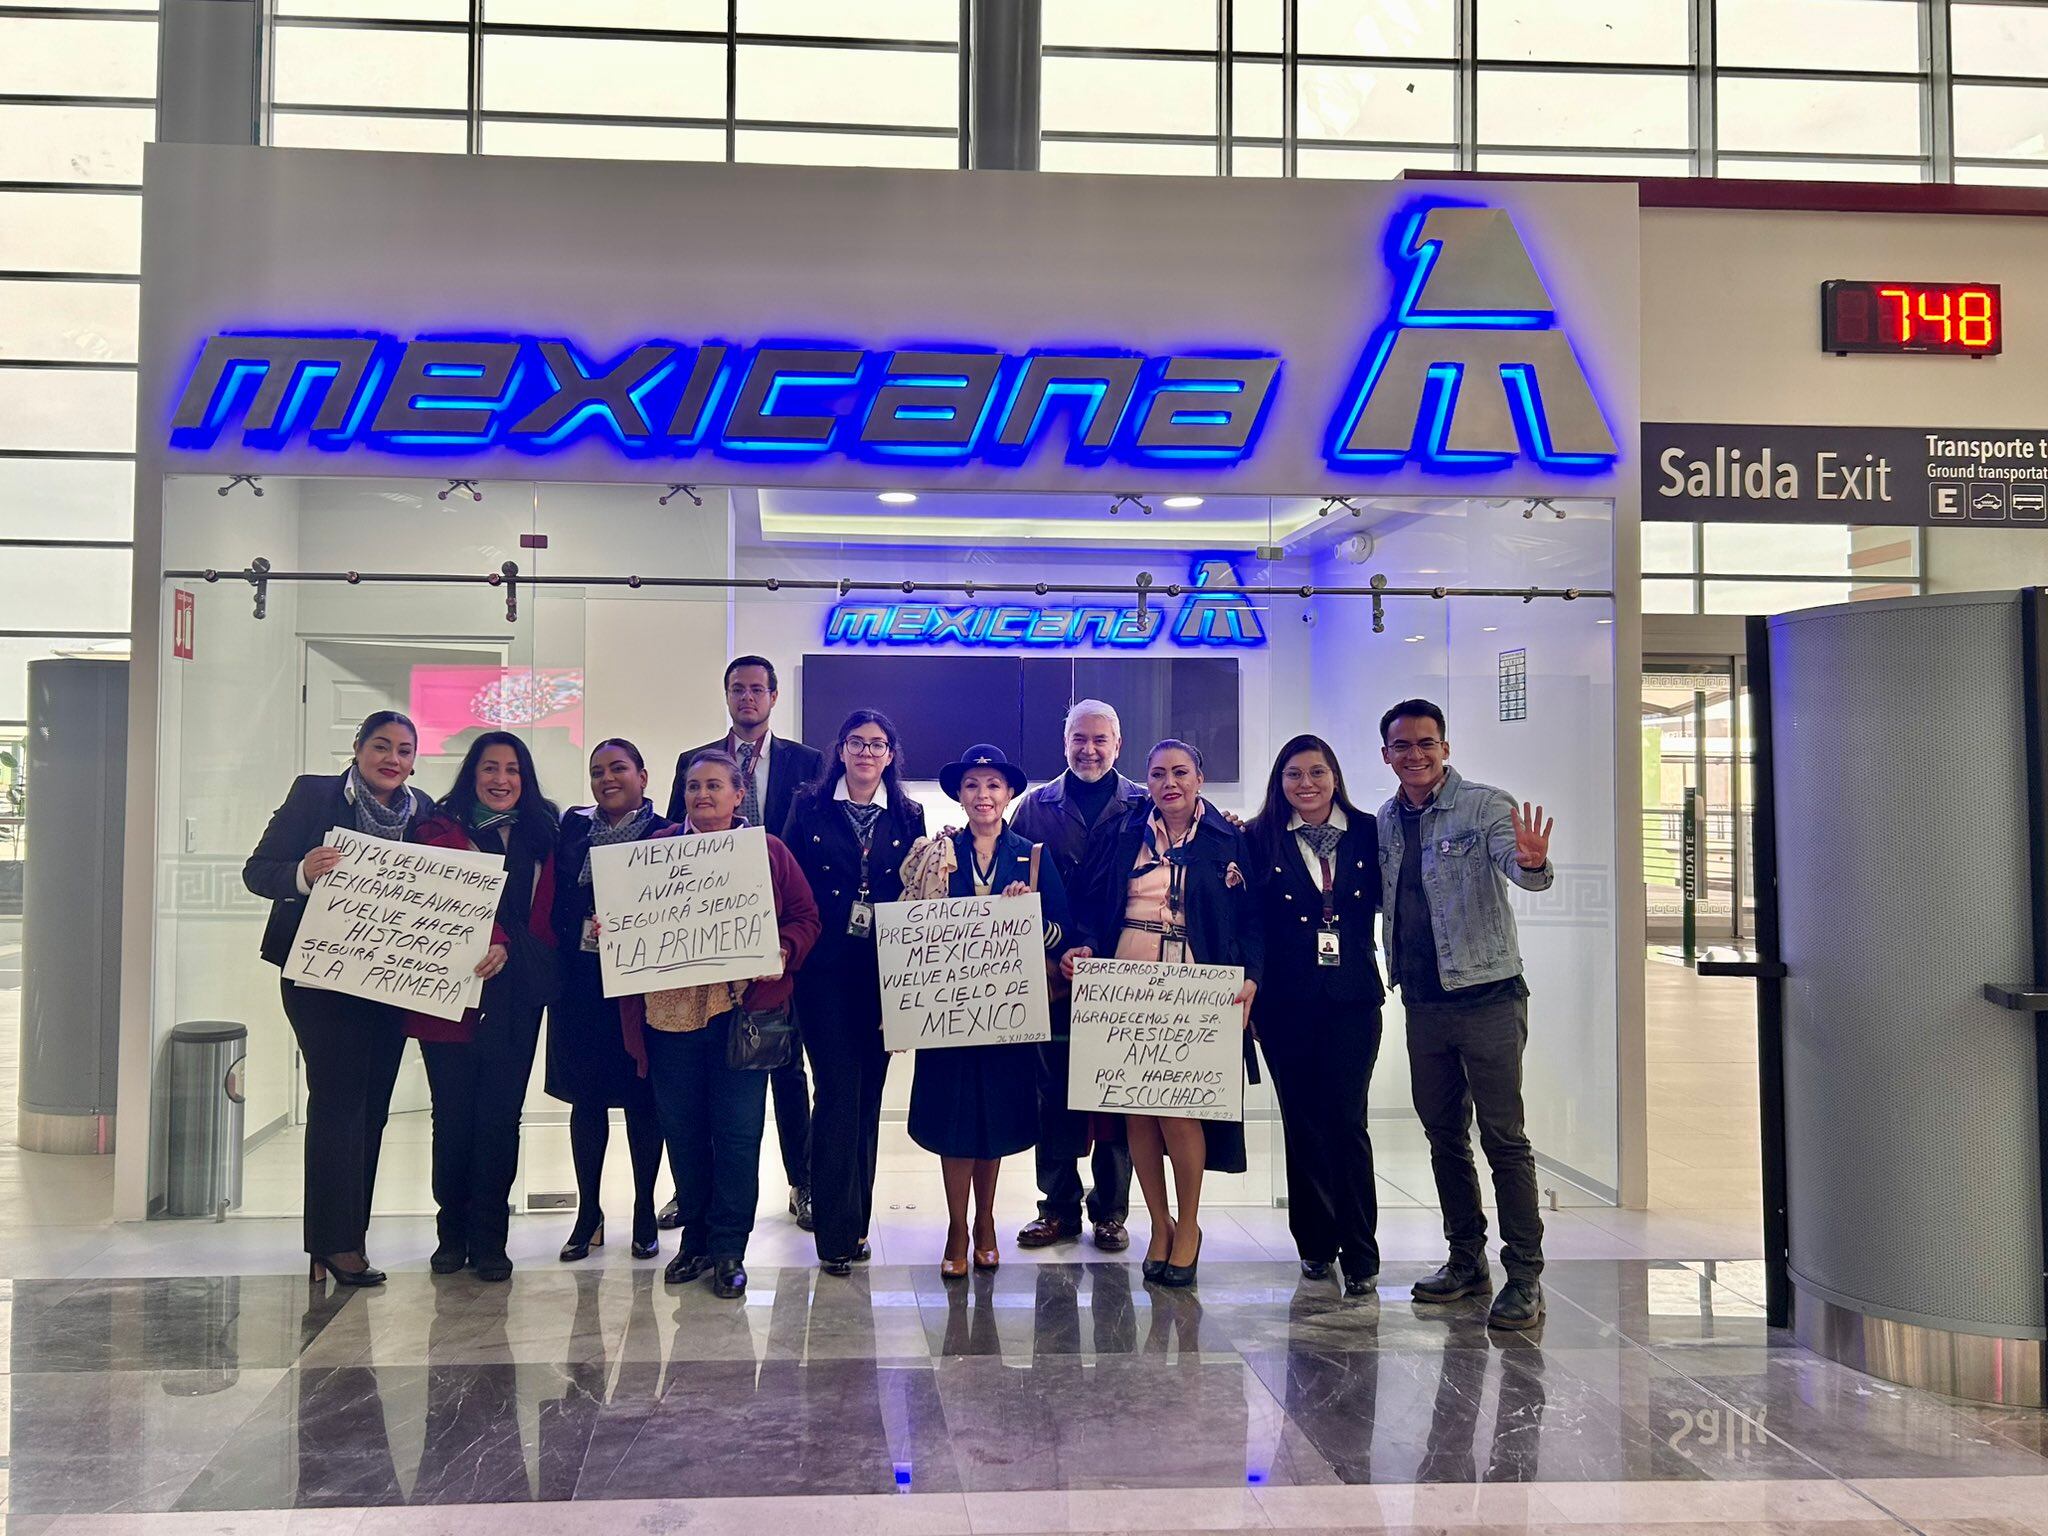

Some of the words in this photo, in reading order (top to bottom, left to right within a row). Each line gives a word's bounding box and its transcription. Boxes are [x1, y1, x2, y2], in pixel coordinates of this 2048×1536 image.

[1926, 435, 2035, 463] Transporte
[1658, 447, 1799, 499] Salida
[1816, 452, 1892, 502] Exit
[1927, 463, 1975, 478] Ground
[1938, 488, 1958, 513] E
[333, 834, 370, 865] HOY
[368, 847, 392, 867] 26
[393, 853, 416, 869] DE
[414, 856, 501, 892] DICIEMBRE
[628, 835, 735, 868] MEXICANA
[376, 867, 416, 883] 2023
[669, 864, 693, 879] DE
[316, 870, 403, 901] MEXICANA
[403, 889, 424, 905] DE
[420, 892, 496, 921] AVIACIÓN
[639, 871, 730, 902] AVIACIÓN
[327, 896, 406, 926] VUELVE
[411, 916, 475, 944] HACER
[907, 901, 992, 923] GRACIAS
[607, 937, 647, 968] "LA
[656, 910, 771, 964] PRIMERA"
[878, 922, 985, 947] "PRESIDENTE
[990, 914, 1035, 936] AMLO"
[301, 938, 379, 962] SEGUIRÁ
[383, 954, 449, 976] SIENDO
[907, 938, 1019, 968] MEXICANA
[302, 953, 344, 981] "LA
[360, 966, 471, 1004] PRIMERA"
[882, 970, 942, 990] VUELVE
[945, 968, 956, 984] A
[958, 959, 1023, 981] SURCAR
[1148, 976, 1165, 987] DE
[1162, 966, 1235, 981] JUBILADOS
[899, 991, 925, 1010] EL
[934, 983, 997, 1004] CIELO
[1005, 979, 1029, 997] DE
[1074, 984, 1154, 1003] MEXICANA
[1158, 990, 1173, 1001] DE
[1173, 987, 1236, 1007] AVIACIÓN
[920, 1001, 1026, 1038] MÉXICO
[1072, 1010, 1169, 1025] AGRADECEMOS
[1173, 1013, 1190, 1025] AL
[1199, 1014, 1222, 1025] SR.
[1107, 1026, 1218, 1044] PRESIDENTE
[1123, 1043, 1190, 1065] AMLO
[1095, 1068, 1126, 1084] POR
[1142, 1069, 1223, 1085] HABERNOS
[1100, 1084, 1225, 1106] "ESCUCHADO"
